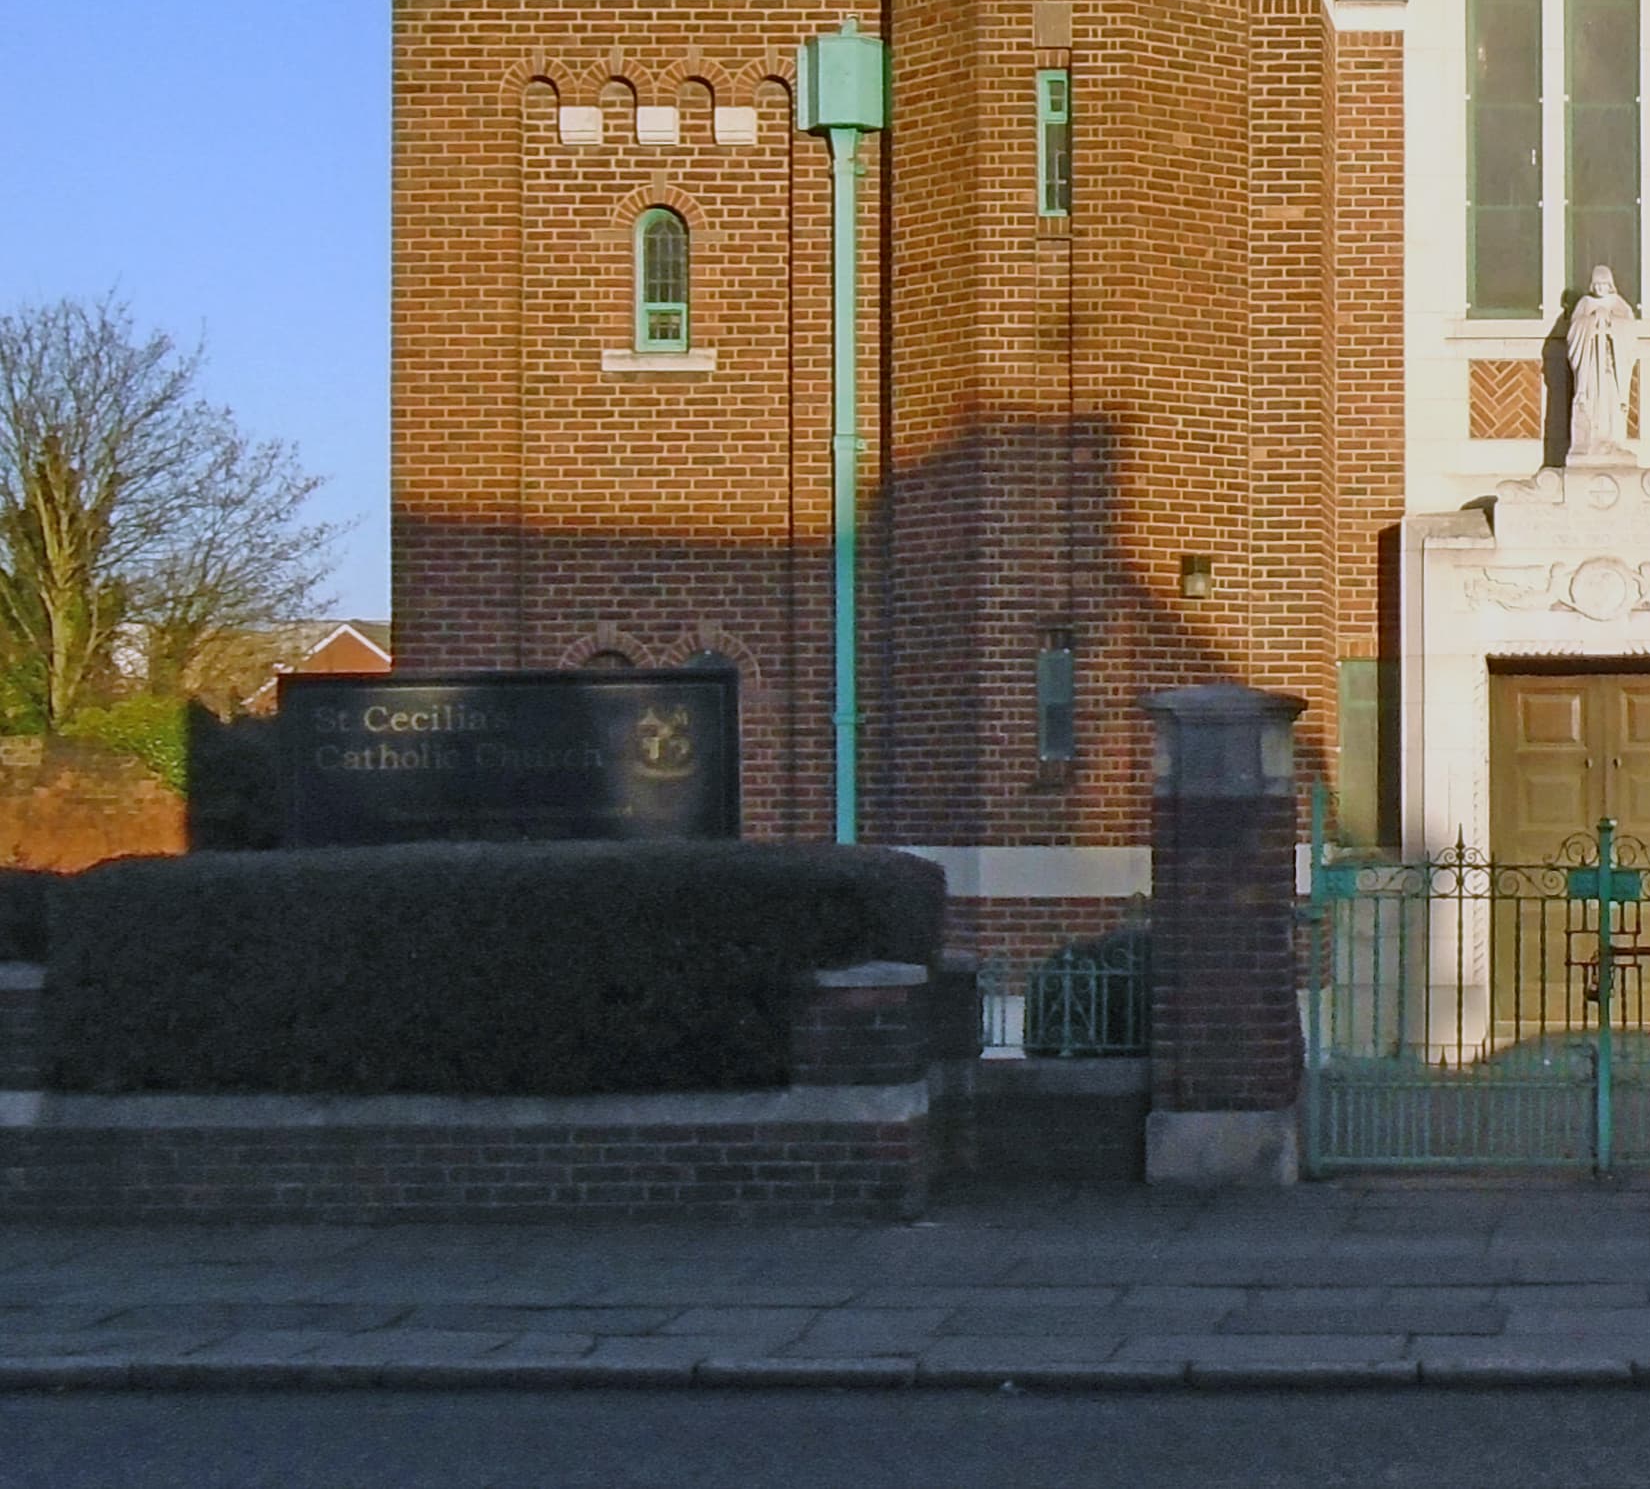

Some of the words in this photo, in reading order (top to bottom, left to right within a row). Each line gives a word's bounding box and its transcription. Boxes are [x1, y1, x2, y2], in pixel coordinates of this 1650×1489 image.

[314, 706, 351, 733] St
[315, 742, 461, 770] Catholic
[475, 741, 604, 769] Church
